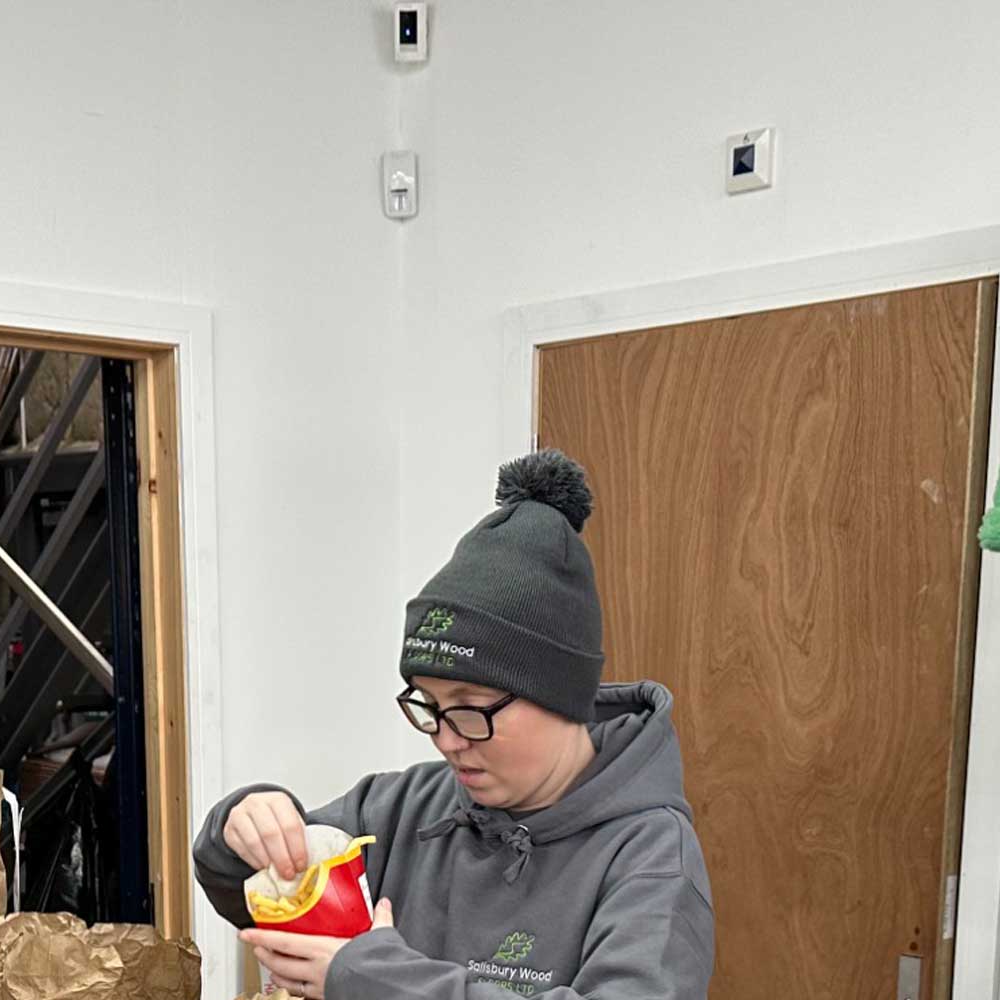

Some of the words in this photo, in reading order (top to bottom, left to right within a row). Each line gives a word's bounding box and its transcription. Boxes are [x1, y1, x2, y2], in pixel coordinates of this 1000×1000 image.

[440, 640, 475, 657] Wood
[467, 959, 517, 981] Salisbury
[520, 966, 553, 981] Wood
[516, 983, 534, 996] LTD
